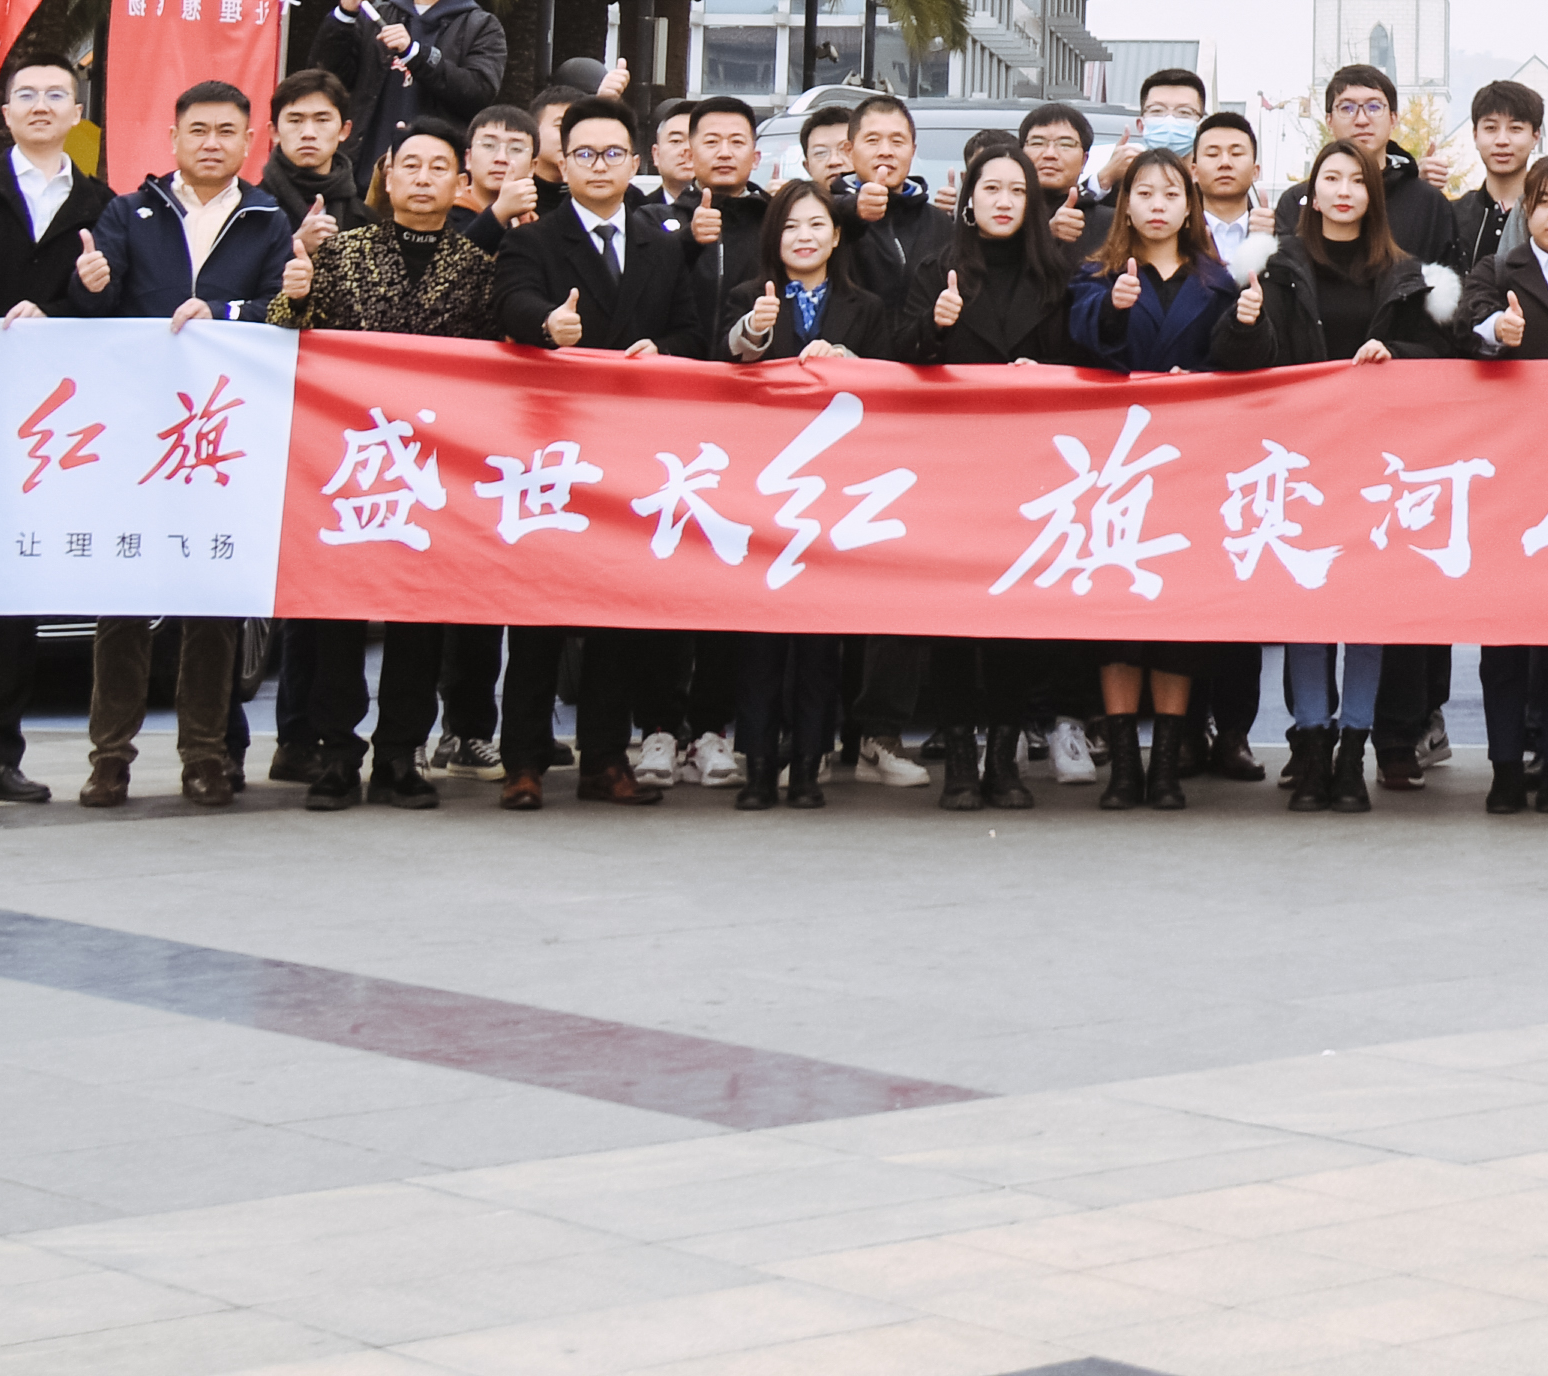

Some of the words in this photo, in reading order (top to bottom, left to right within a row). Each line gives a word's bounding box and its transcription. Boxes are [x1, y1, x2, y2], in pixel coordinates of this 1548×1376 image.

[17, 374, 245, 493] 红旗
[16, 532, 236, 560] 让理想飞扬
